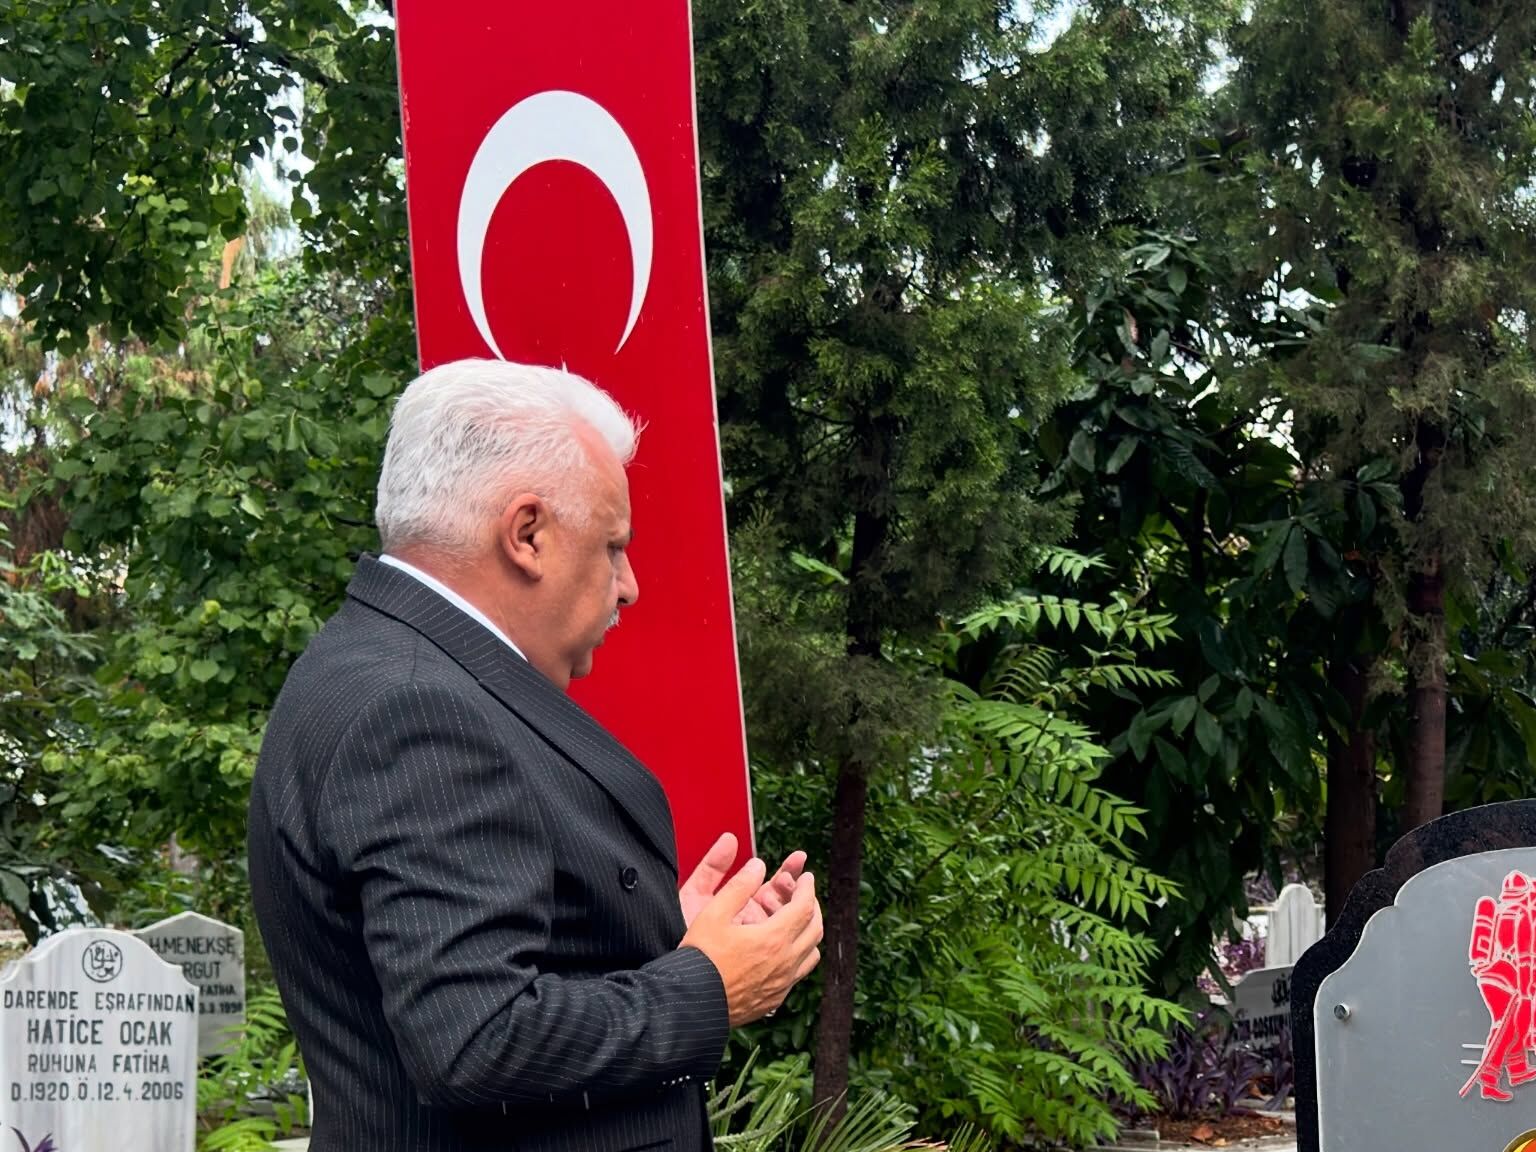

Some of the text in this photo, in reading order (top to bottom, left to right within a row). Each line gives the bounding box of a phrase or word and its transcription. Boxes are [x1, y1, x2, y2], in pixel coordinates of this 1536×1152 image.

[182, 961, 221, 979] RGUT
[4, 990, 195, 1014] DARENDE EŞRAFINDAN
[27, 1014, 172, 1045] HATİCE OCAK
[28, 1050, 170, 1074] RUHUNA FATİHA
